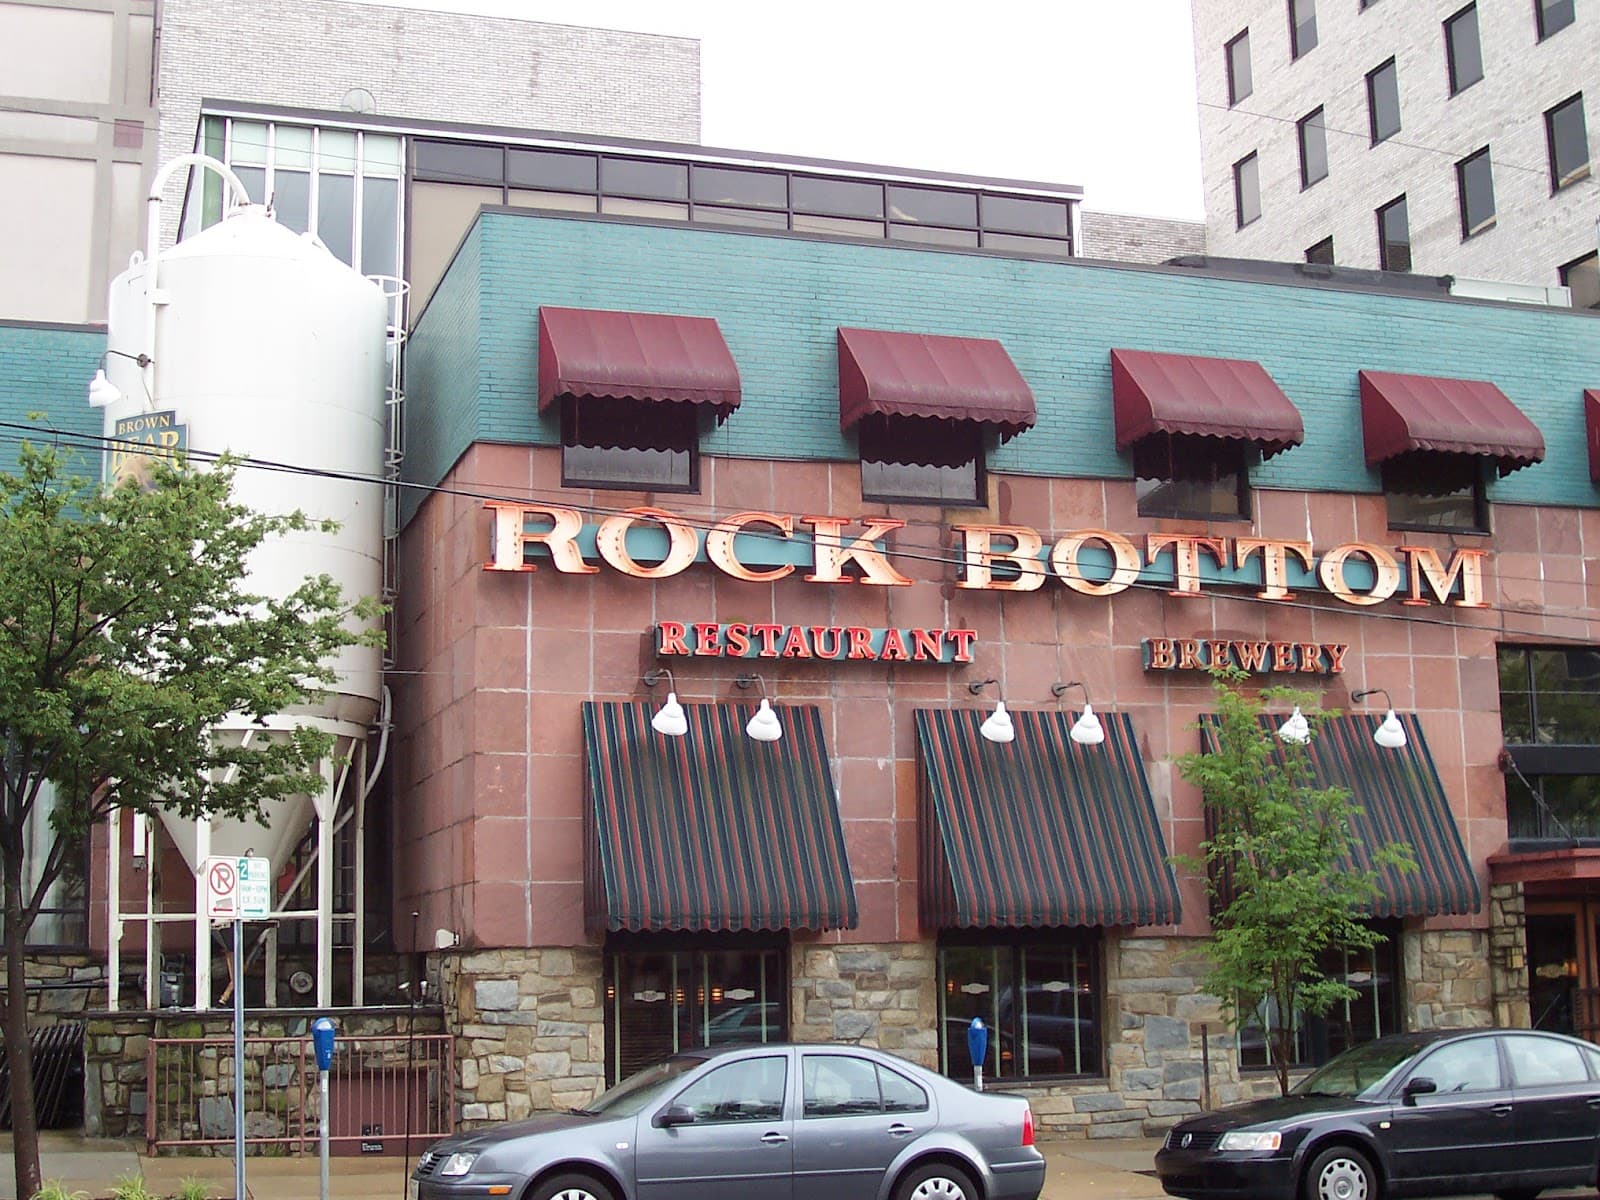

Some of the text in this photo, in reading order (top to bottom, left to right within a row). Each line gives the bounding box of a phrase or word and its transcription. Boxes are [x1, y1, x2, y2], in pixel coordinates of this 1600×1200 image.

[118, 414, 171, 435] BROWN
[111, 430, 183, 475] BEAR
[482, 499, 1491, 608] ROCK BOTTOM
[658, 620, 978, 663] RESTAURANT
[1148, 638, 1348, 674] BREWERY
[240, 862, 248, 878] 2
